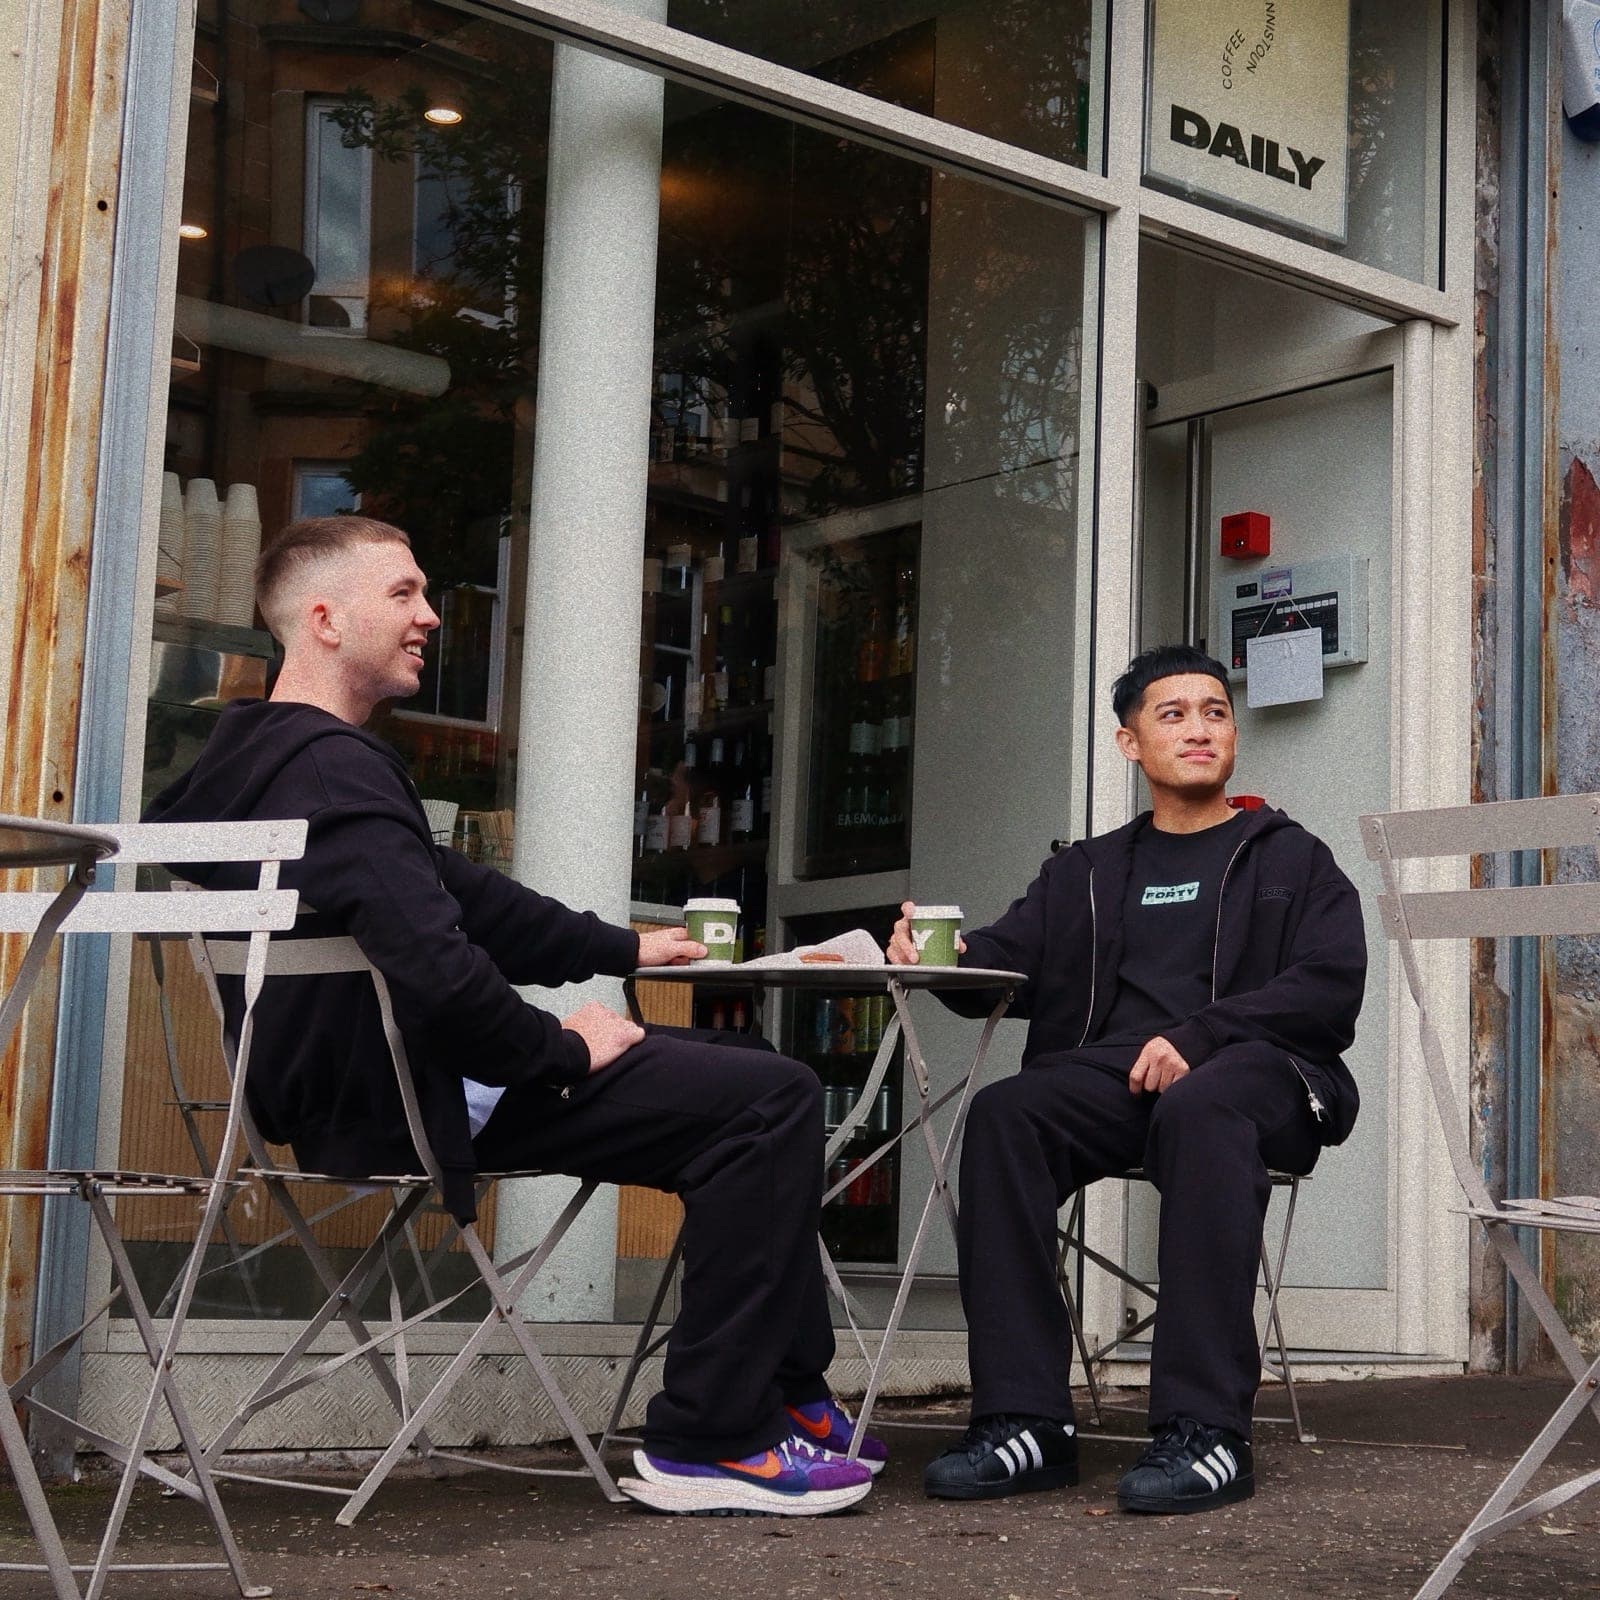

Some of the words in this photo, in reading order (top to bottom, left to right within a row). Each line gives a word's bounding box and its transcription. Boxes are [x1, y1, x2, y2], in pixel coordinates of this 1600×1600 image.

[1221, 28, 1246, 90] COFFEE
[1170, 103, 1326, 191] DAILY
[1145, 888, 1195, 900] FORTY
